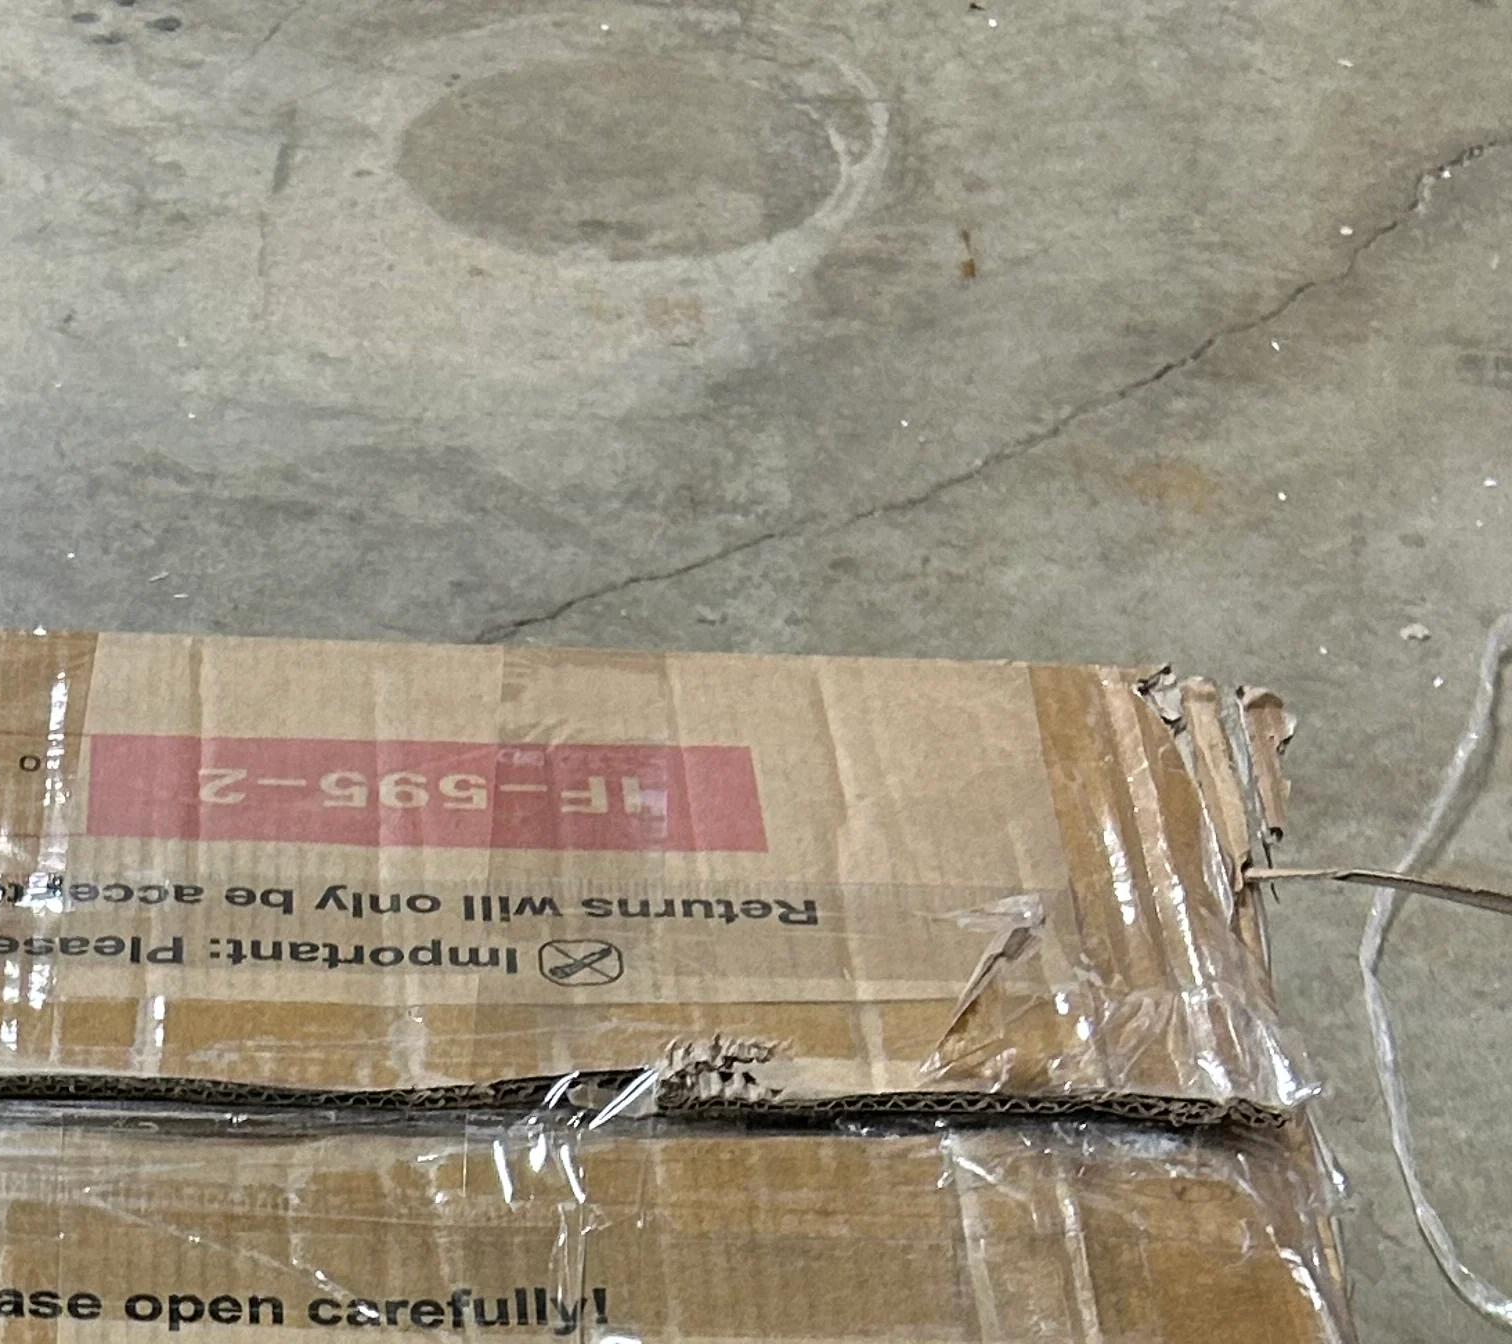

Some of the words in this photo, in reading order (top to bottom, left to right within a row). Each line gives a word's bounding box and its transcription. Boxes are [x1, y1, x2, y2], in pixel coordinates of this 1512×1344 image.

[195, 766, 649, 815] IF-595-2
[225, 885, 292, 916] be
[315, 884, 440, 919] only
[462, 894, 561, 922] will
[581, 894, 818, 926] Returns
[208, 934, 517, 974] Important:
[125, 1292, 284, 1330] open
[307, 1288, 610, 1334] carefully!
